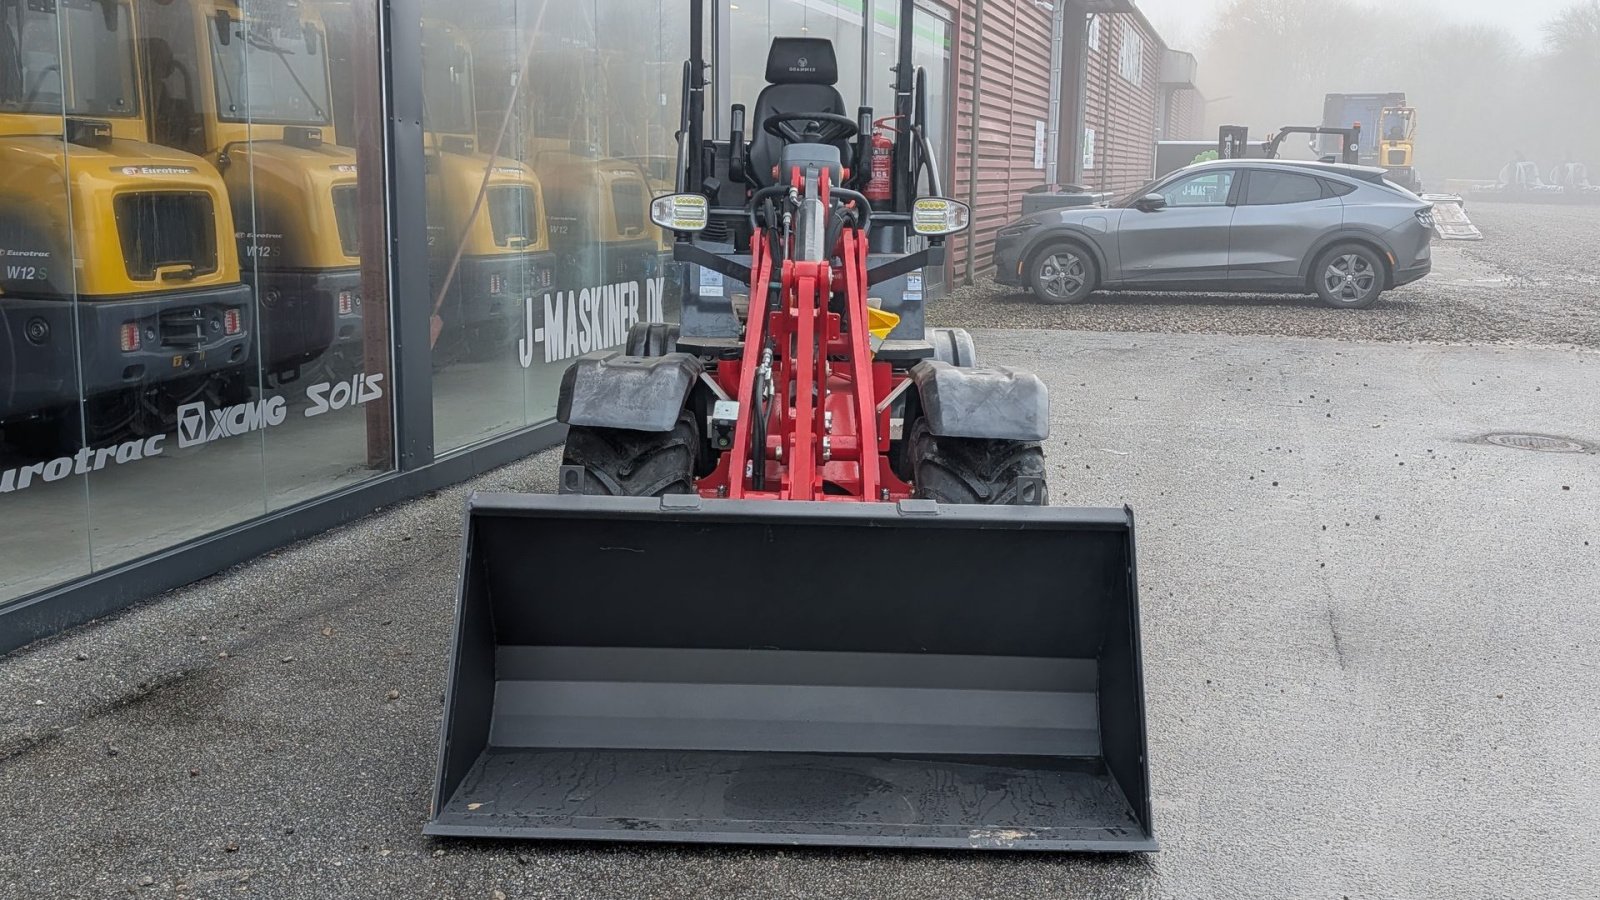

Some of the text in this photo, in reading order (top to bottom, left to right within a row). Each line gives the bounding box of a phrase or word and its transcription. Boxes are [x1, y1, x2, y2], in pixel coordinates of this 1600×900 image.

[6, 249, 50, 257] Eurotrac
[7, 265, 48, 280] W12 S
[206, 395, 287, 441] XCMG
